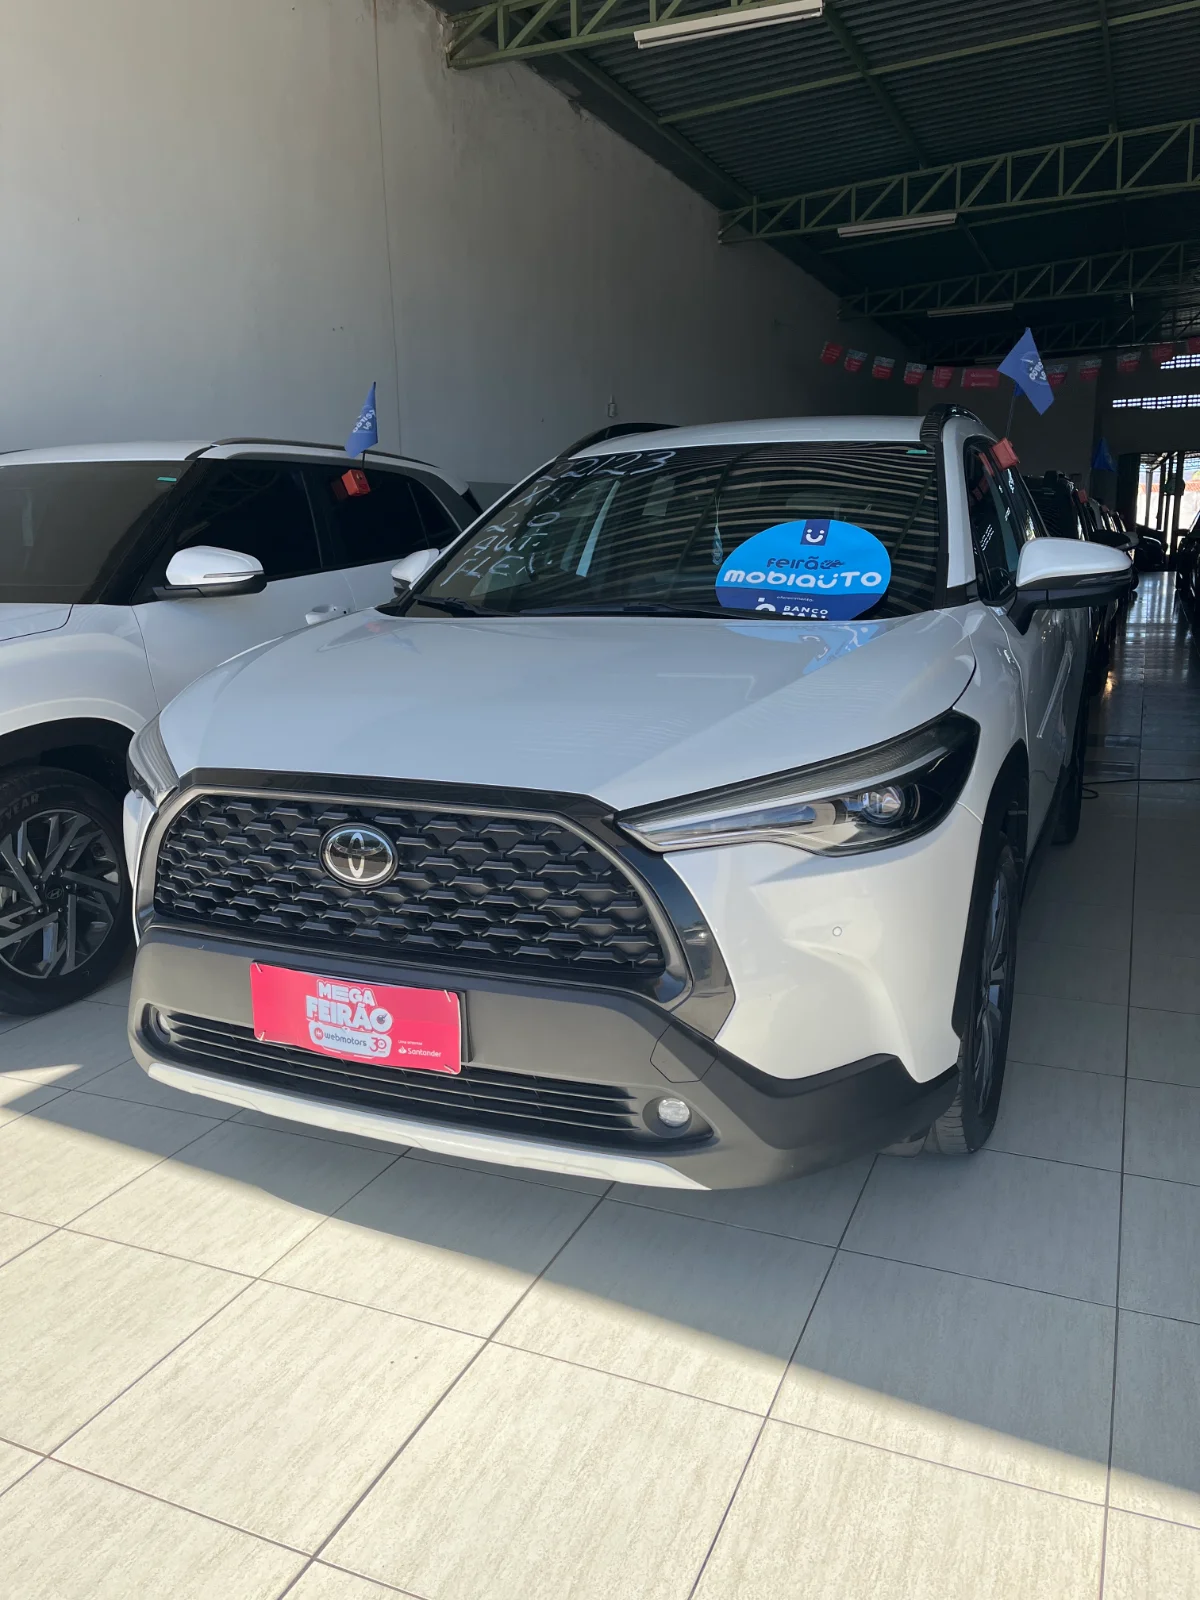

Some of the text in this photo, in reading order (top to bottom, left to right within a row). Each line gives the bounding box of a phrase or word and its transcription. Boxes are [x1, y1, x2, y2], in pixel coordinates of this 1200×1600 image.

[783, 605, 829, 615] BANCO
[318, 981, 376, 1007] MEGA
[306, 995, 393, 1033] FEIRÃO
[324, 1032, 368, 1047] webmotors
[407, 1047, 442, 1058] Santander
